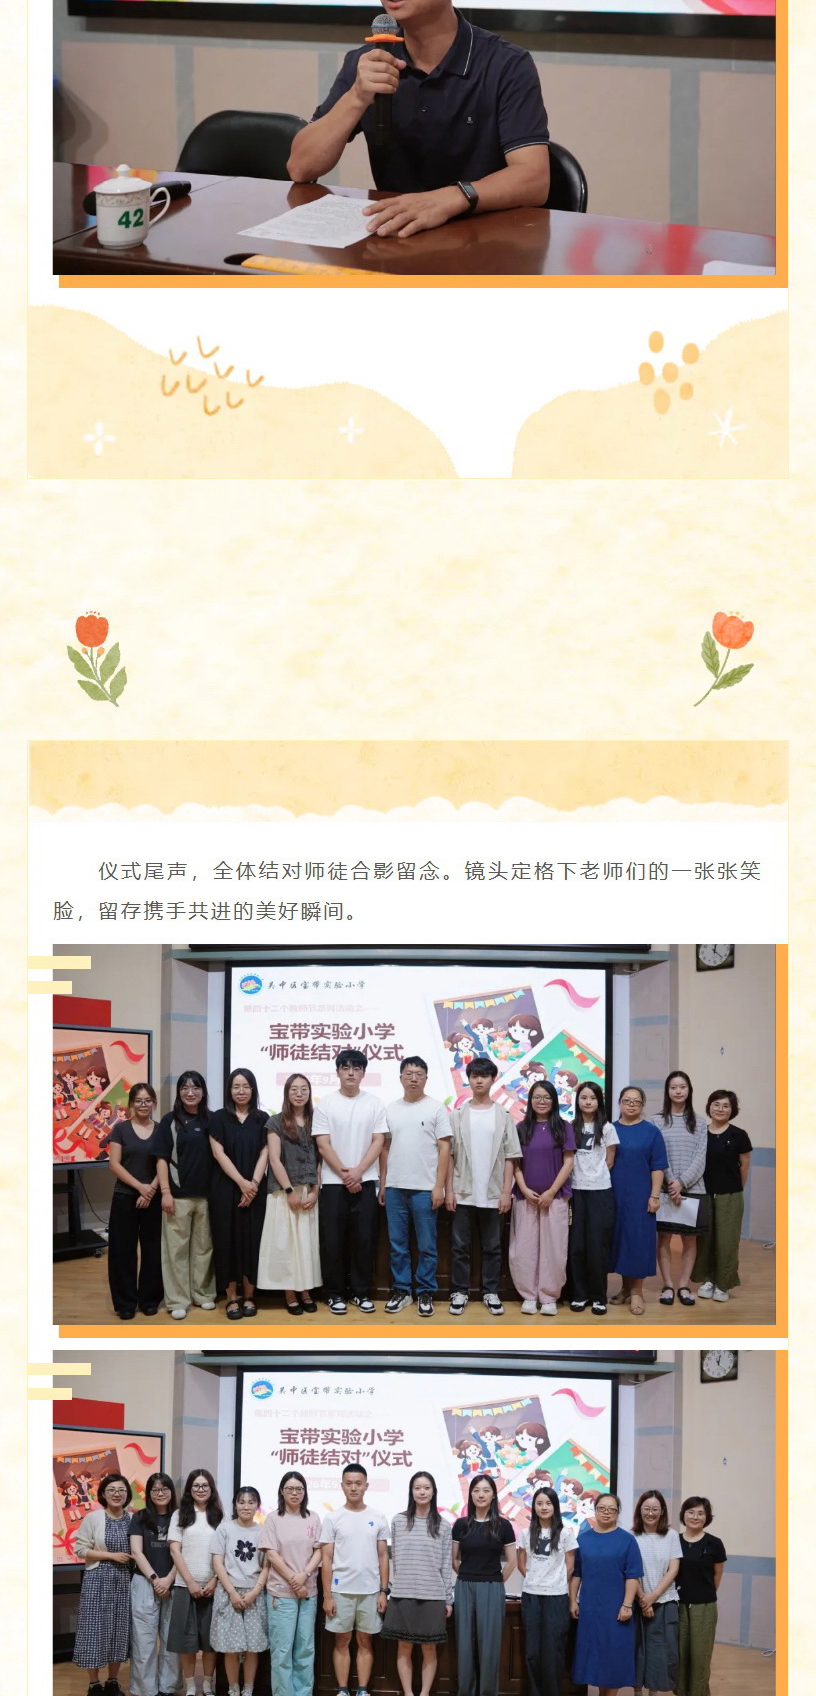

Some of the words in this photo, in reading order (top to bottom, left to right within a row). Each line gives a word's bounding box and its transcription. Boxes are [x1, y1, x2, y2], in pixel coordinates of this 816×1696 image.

[117, 208, 144, 229] 42
[269, 1023, 395, 1040] 宝带实验小学
[279, 1428, 404, 1446] 宝带实验小学
